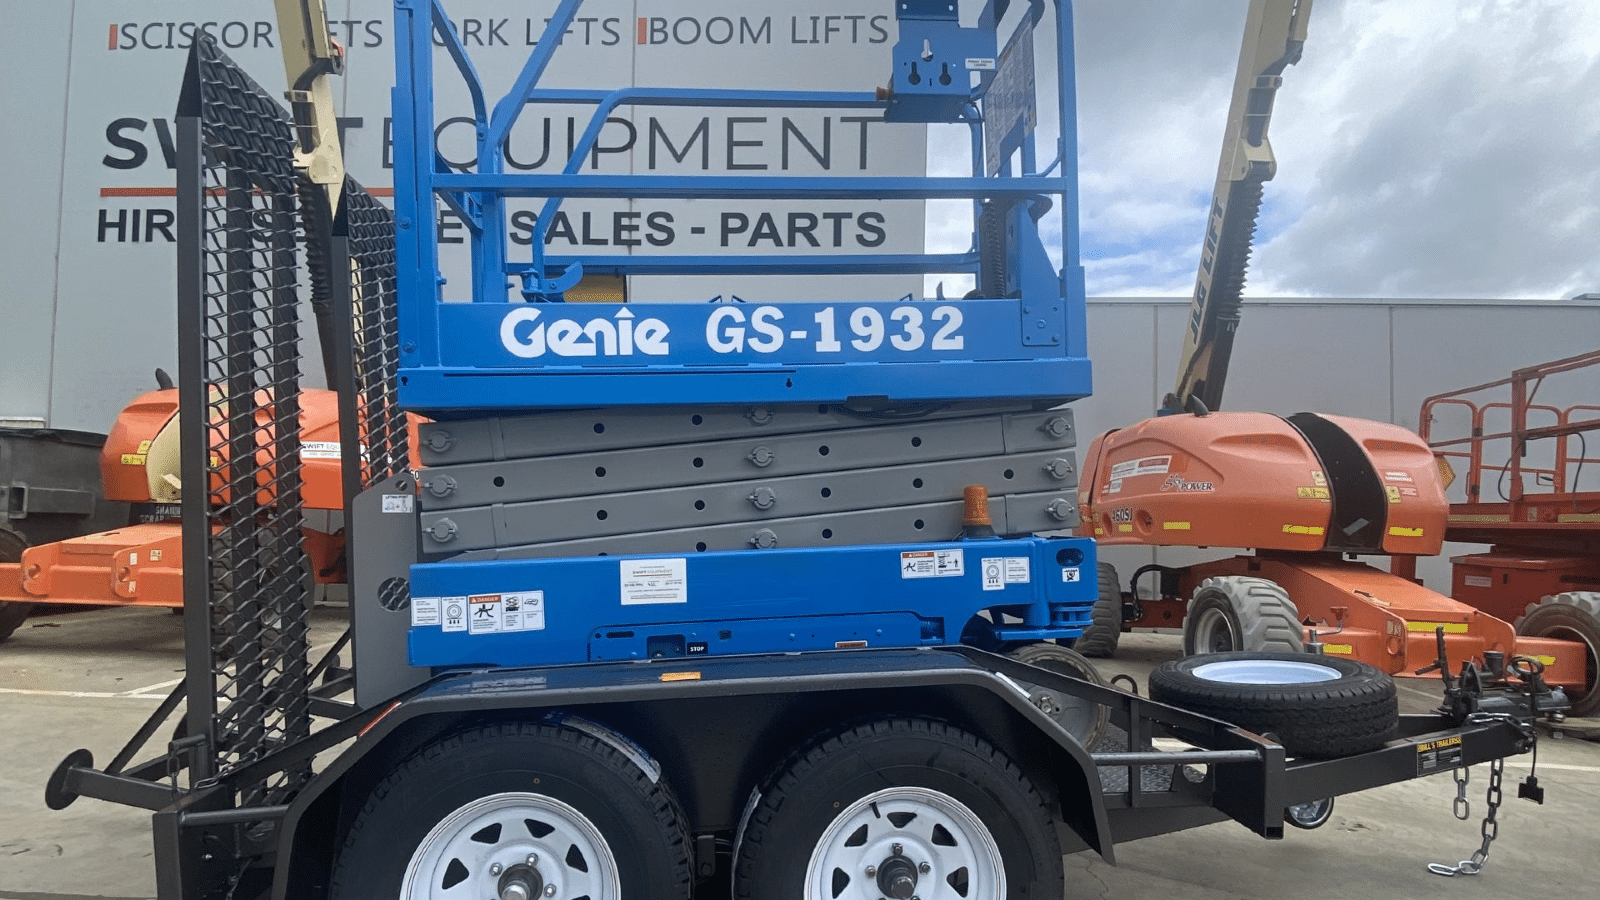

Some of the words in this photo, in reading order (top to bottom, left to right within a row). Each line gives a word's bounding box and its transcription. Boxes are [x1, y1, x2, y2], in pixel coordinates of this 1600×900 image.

[119, 21, 274, 49] SCISSOR
[432, 18, 509, 46] ORK
[525, 17, 621, 46] LTS
[650, 16, 771, 45] BOOM
[790, 15, 889, 44] LIFTS
[97, 208, 177, 243] HIR
[509, 210, 676, 247] SALES
[720, 211, 887, 248] PARTS
[1190, 280, 1207, 345] JLG
[1202, 195, 1223, 277] LIFT
[499, 306, 670, 359] Genie
[705, 306, 965, 355] GS-1932
